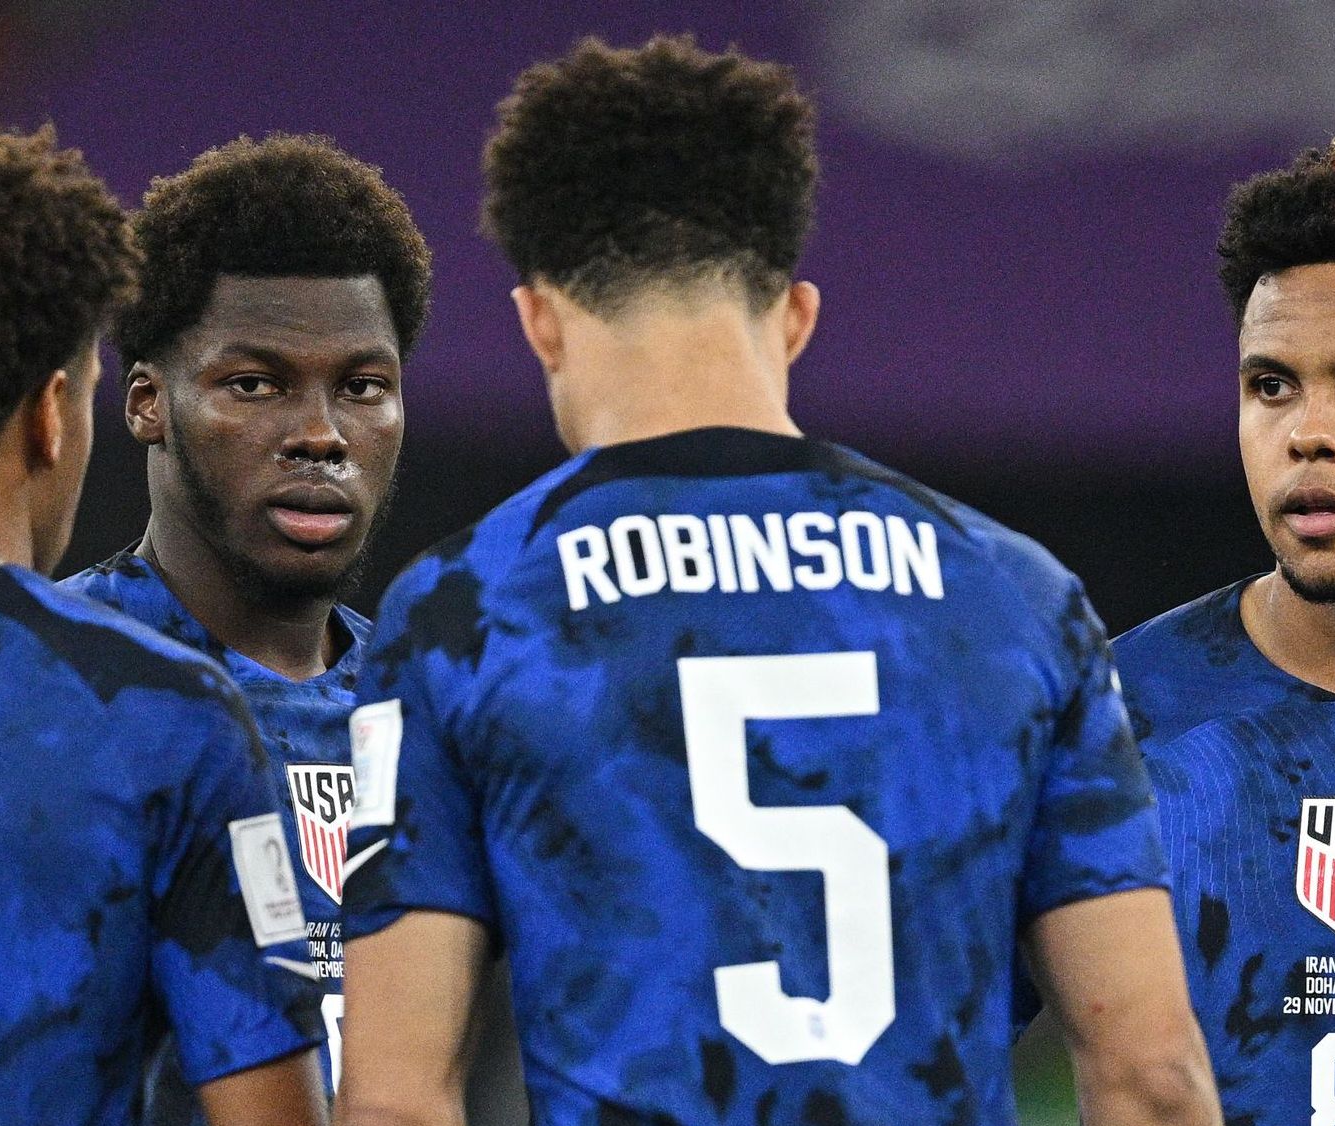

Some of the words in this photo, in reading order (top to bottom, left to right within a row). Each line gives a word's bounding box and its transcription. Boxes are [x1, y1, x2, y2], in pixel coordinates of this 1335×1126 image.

[557, 511, 944, 611] ROBINSON
[293, 771, 356, 824] USA
[677, 651, 896, 1066] 5
[306, 940, 329, 960] OHA,
[1283, 996, 1301, 1014] 29
